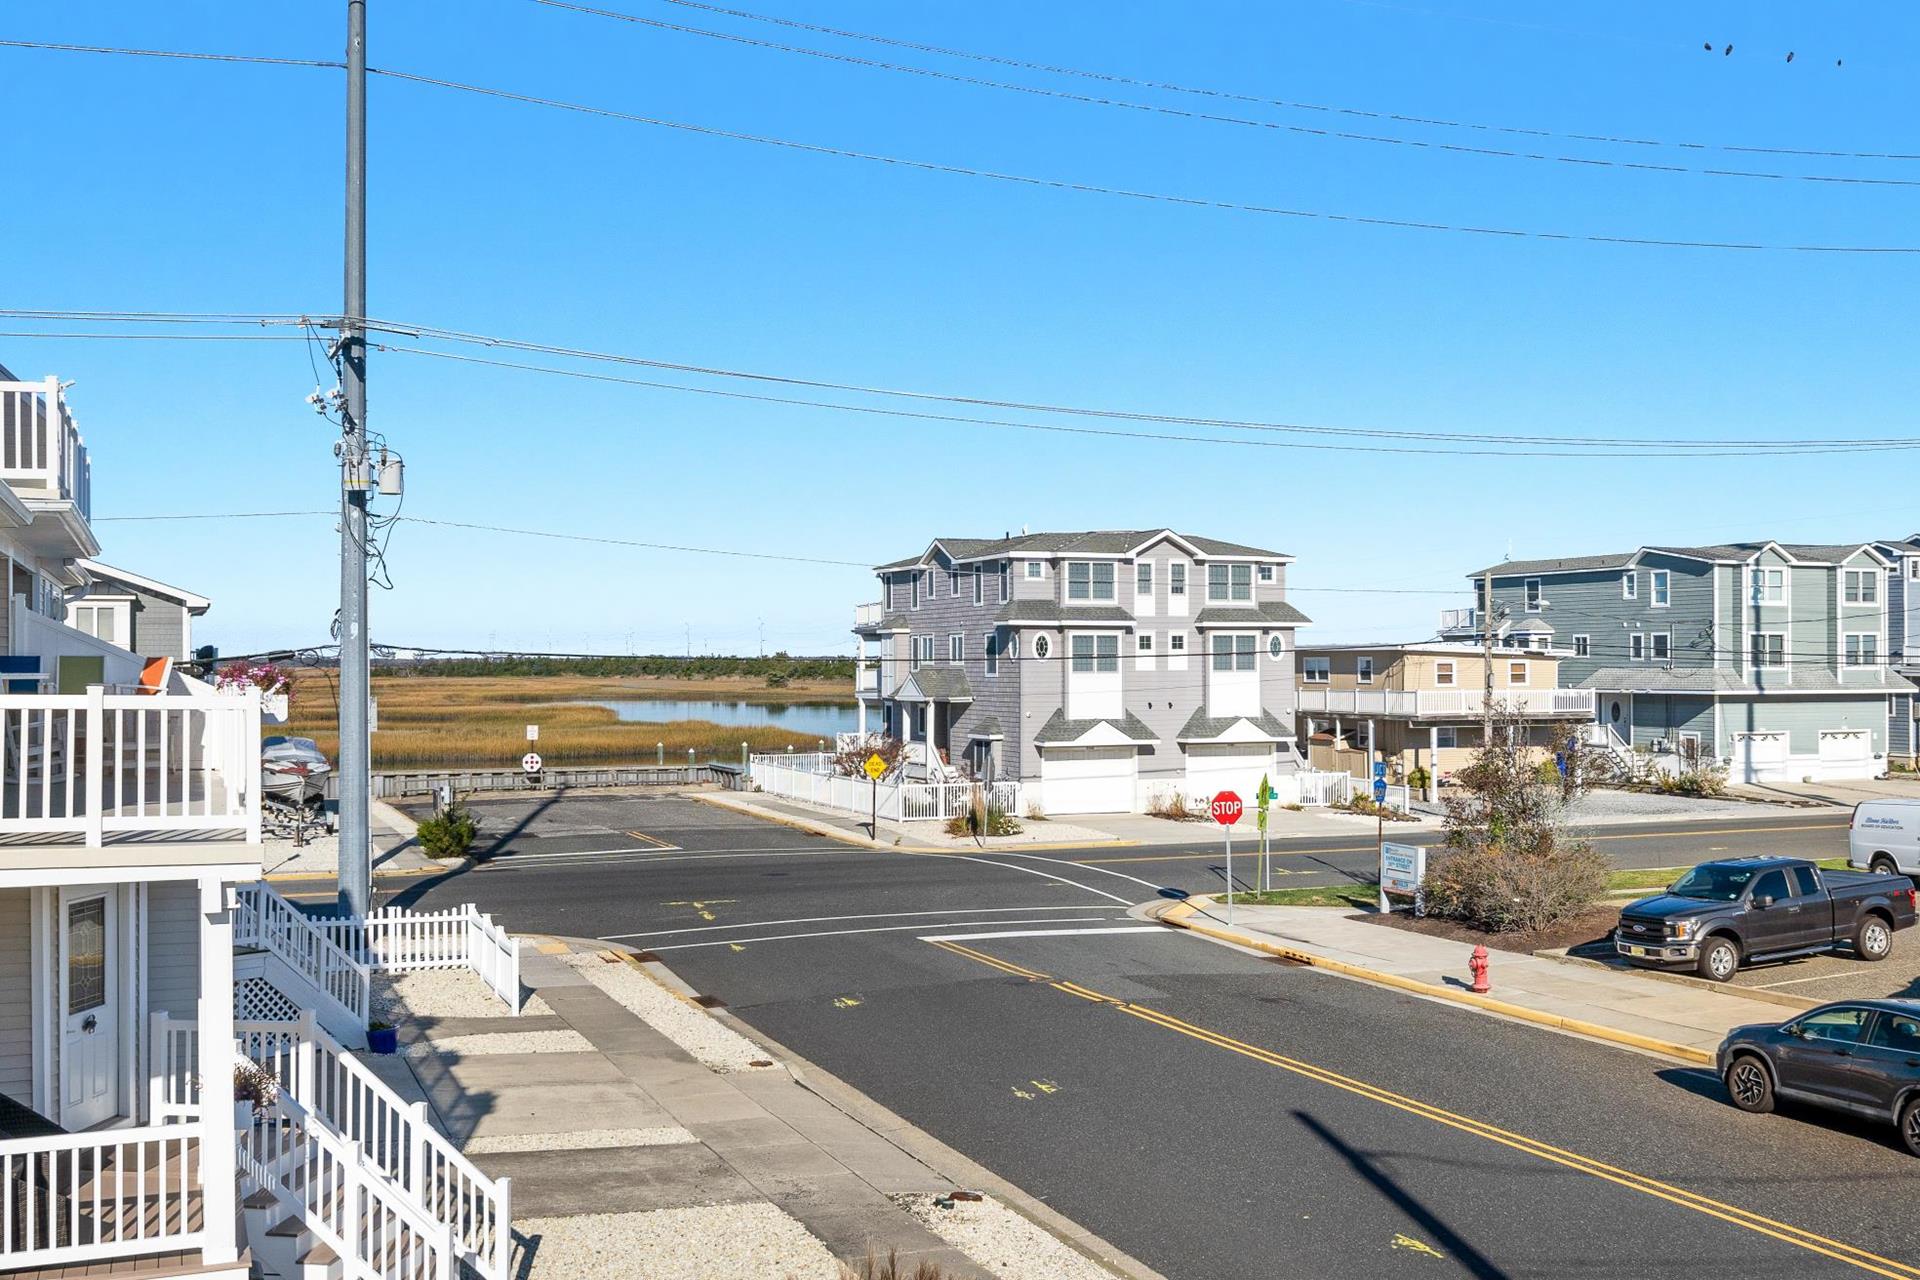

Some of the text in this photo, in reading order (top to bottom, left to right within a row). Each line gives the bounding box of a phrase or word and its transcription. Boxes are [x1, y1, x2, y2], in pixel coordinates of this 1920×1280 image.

[1213, 801, 1241, 815] STOP
[1386, 855, 1405, 863] ENTRANCE
[1396, 862, 1411, 870] STREET
